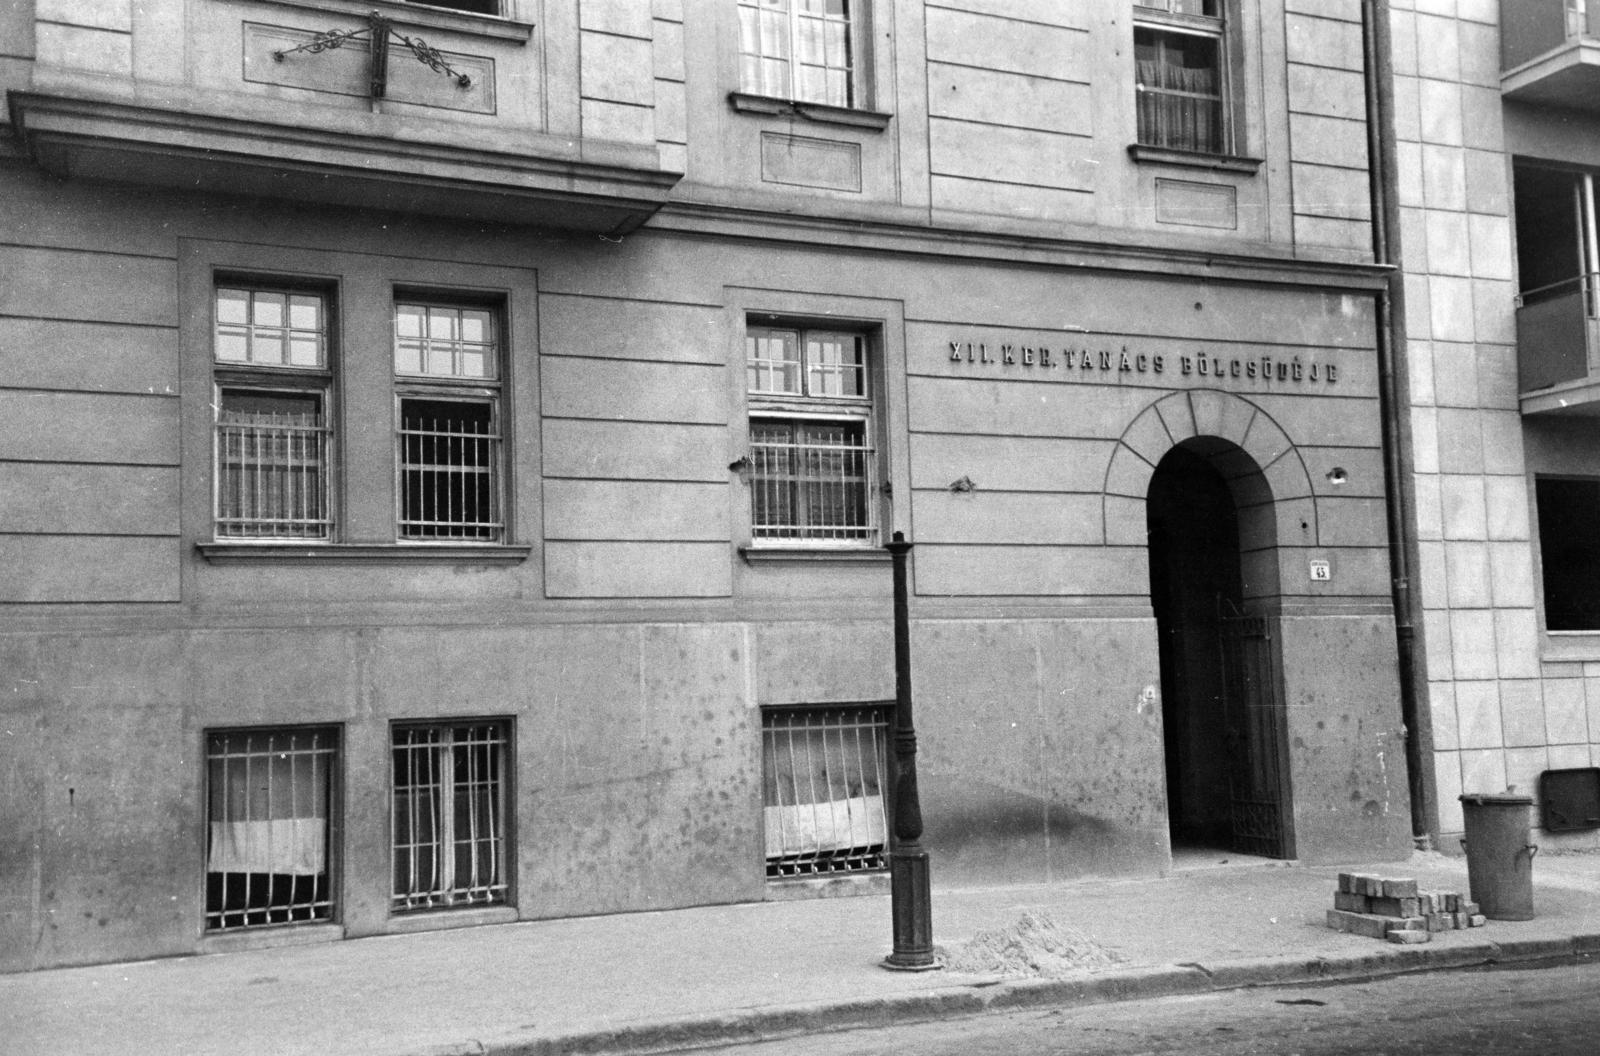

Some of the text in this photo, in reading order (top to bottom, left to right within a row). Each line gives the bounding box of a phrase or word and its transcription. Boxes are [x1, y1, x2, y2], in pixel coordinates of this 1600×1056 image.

[950, 341, 1338, 383] XII. KER. TANÁCS BÖLCSÖDÉJE
